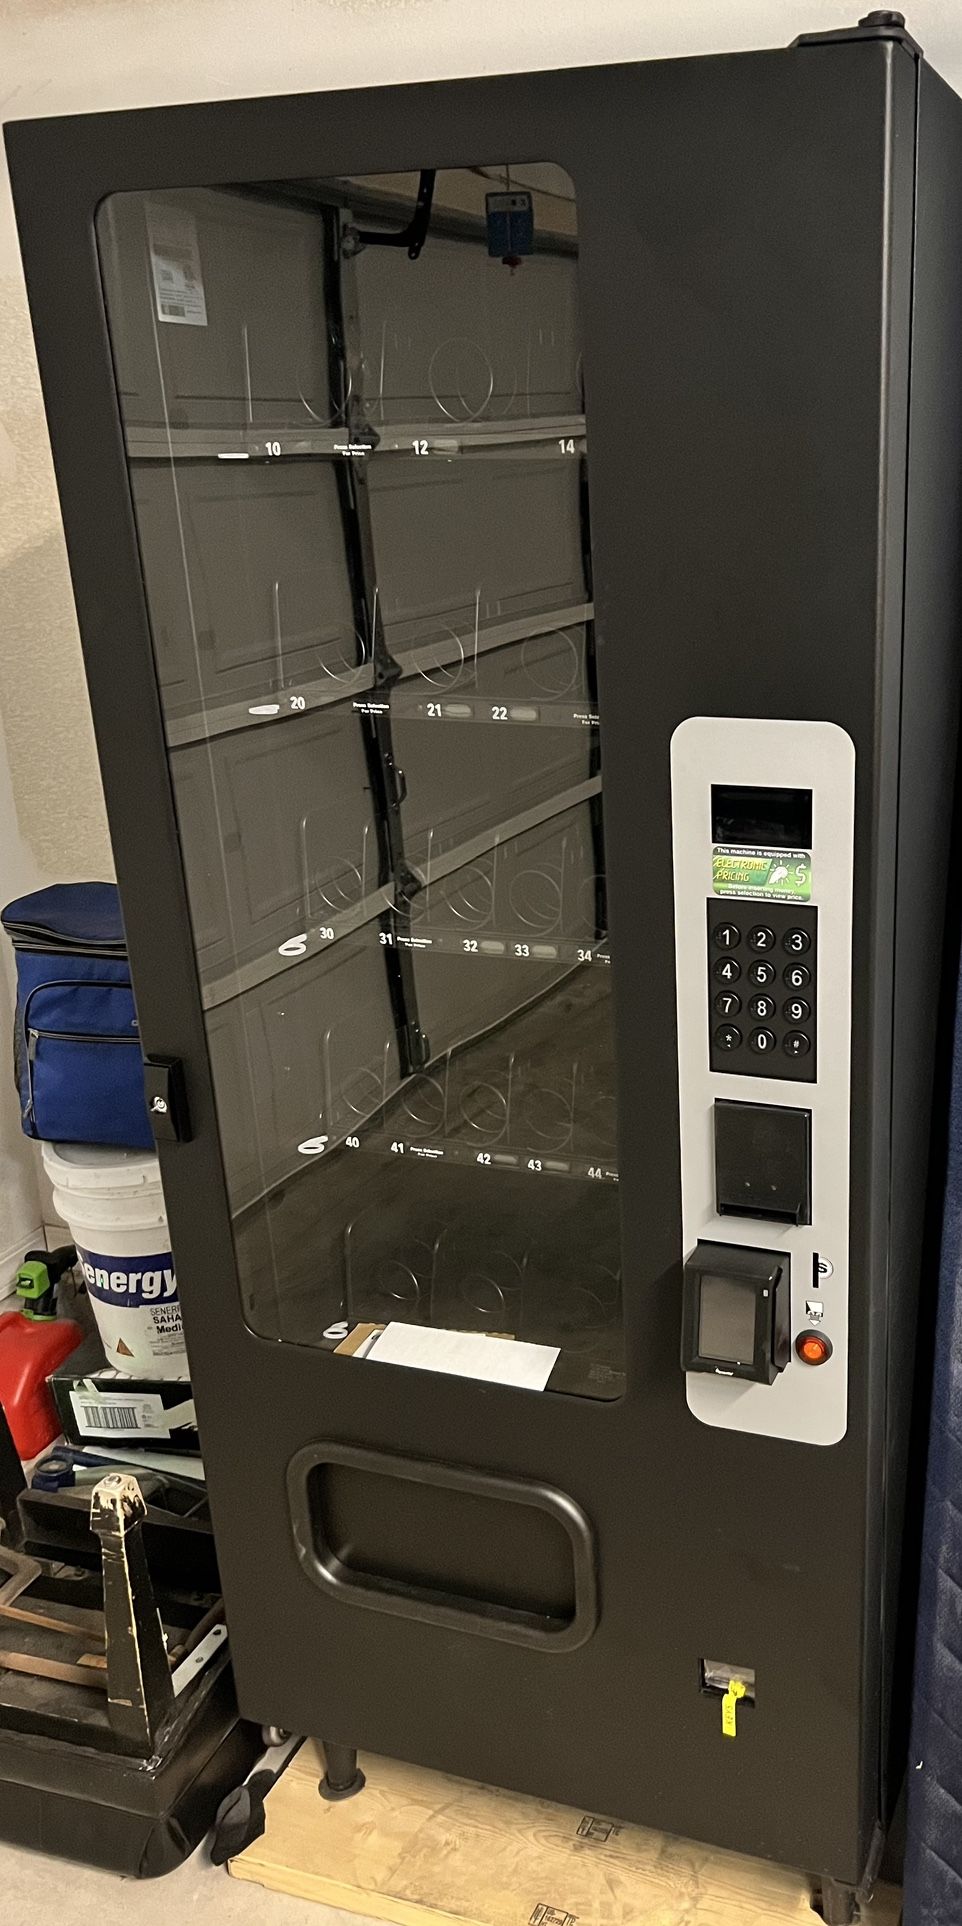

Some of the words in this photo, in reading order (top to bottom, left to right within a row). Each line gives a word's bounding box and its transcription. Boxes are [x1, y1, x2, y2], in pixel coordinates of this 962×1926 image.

[265, 441, 281, 456] 10
[411, 439, 429, 455] 12
[558, 439, 575, 454] 14
[290, 696, 306, 710] 20
[426, 703, 442, 717] 21
[491, 706, 508, 720] 22
[730, 848, 756, 856] machine
[763, 851, 791, 859] equipped
[714, 857, 768, 871] ELECTRONIC
[713, 869, 750, 882] PRICING
[319, 927, 334, 940] 30
[379, 933, 393, 945] 31
[722, 929, 730, 946] 1
[756, 931, 767, 947] 2
[462, 939, 479, 953] 32
[791, 934, 803, 951] 3
[514, 944, 530, 957] 33
[577, 949, 593, 962] 34
[722, 963, 732, 979] 4
[756, 966, 767, 983] 5
[791, 970, 803, 986] 6
[723, 997, 732, 1013] 7
[757, 1000, 767, 1016] 8
[791, 1003, 802, 1019] 9
[757, 1034, 767, 1049] 0
[345, 1136, 360, 1148] 40
[390, 1141, 404, 1154] 41
[476, 1153, 492, 1165] 42
[527, 1159, 542, 1172] 43
[587, 1167, 603, 1179] 44
